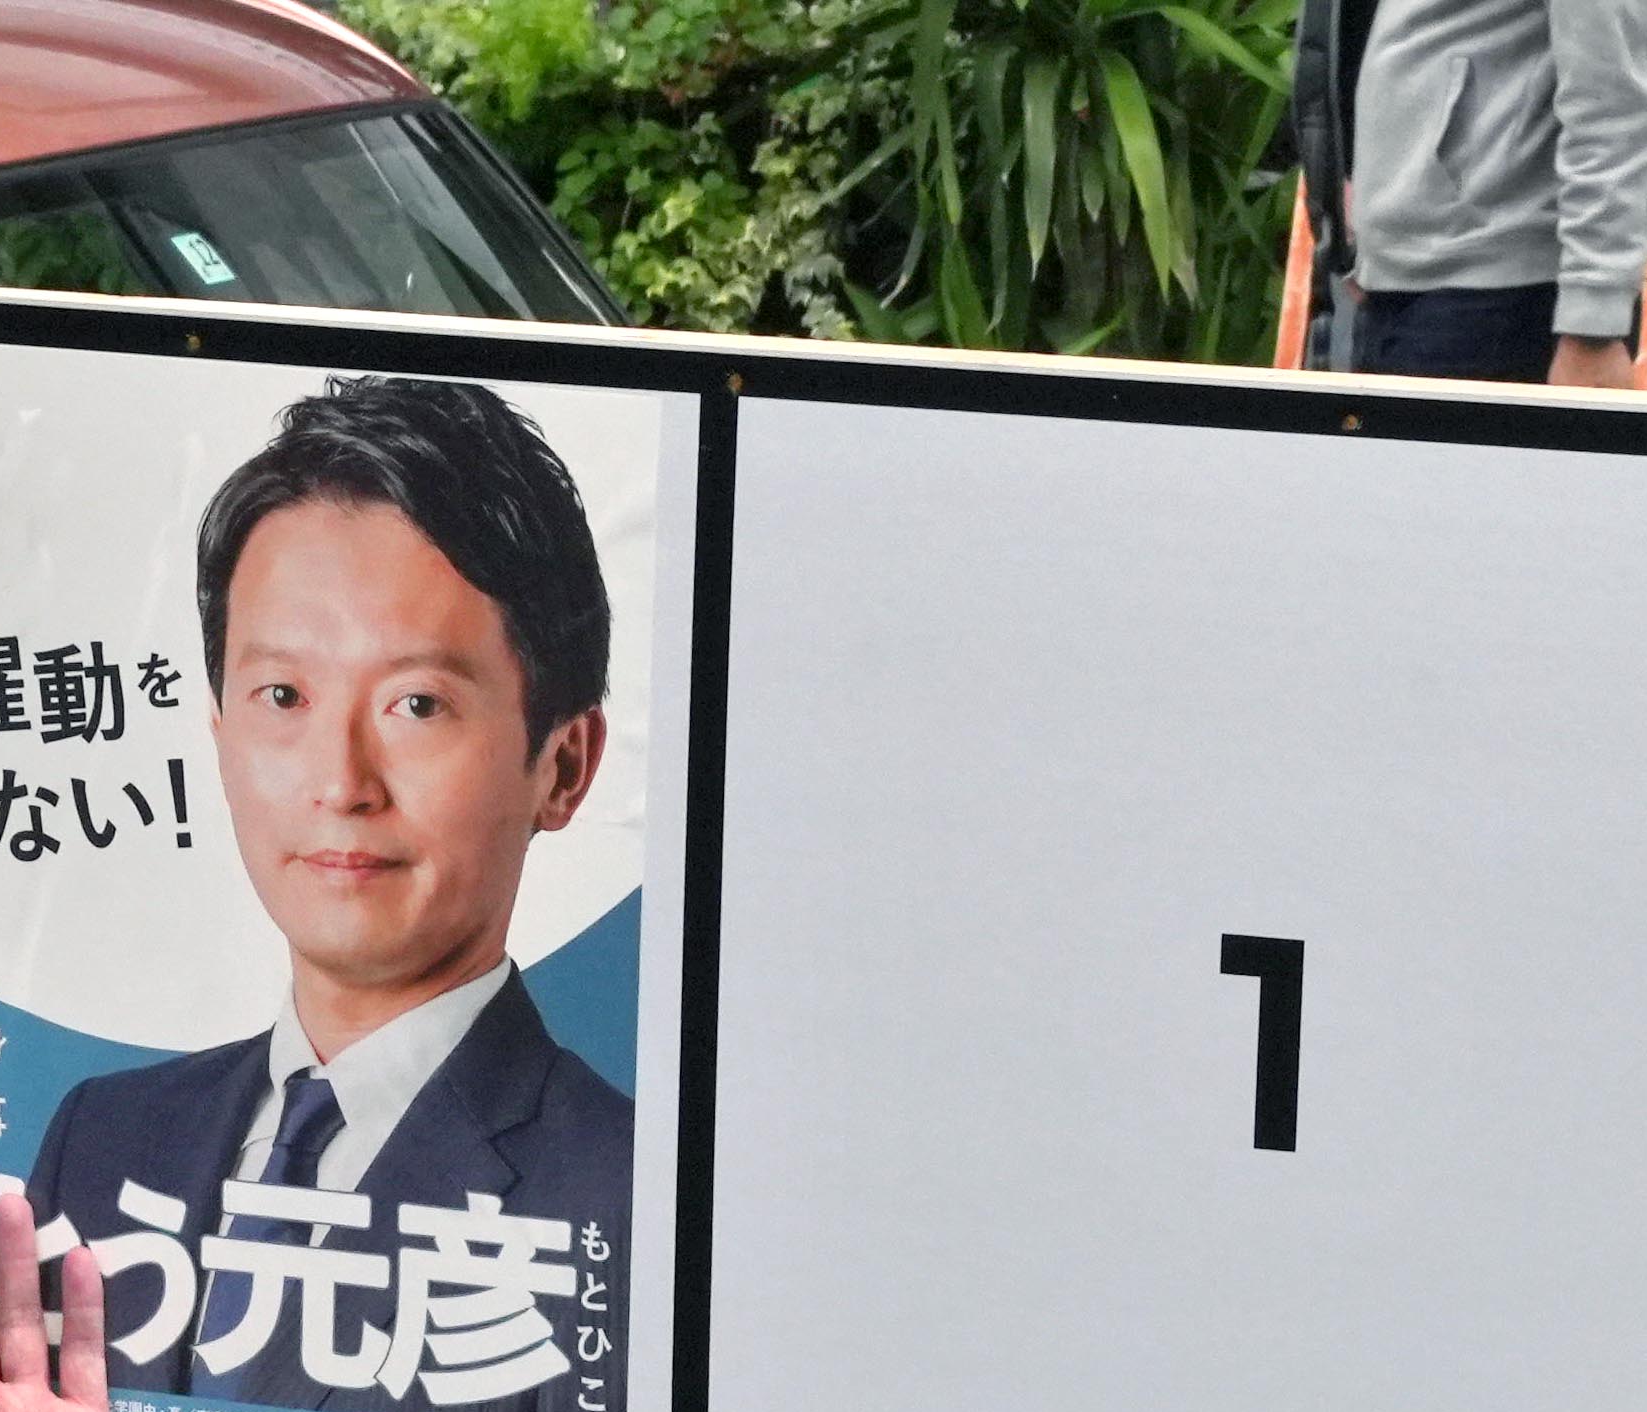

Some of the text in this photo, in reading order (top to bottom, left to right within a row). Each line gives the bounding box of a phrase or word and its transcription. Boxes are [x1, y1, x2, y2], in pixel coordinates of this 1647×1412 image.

[1219, 932, 1306, 1153] 1
[576, 1220, 613, 1412] もとひこ
